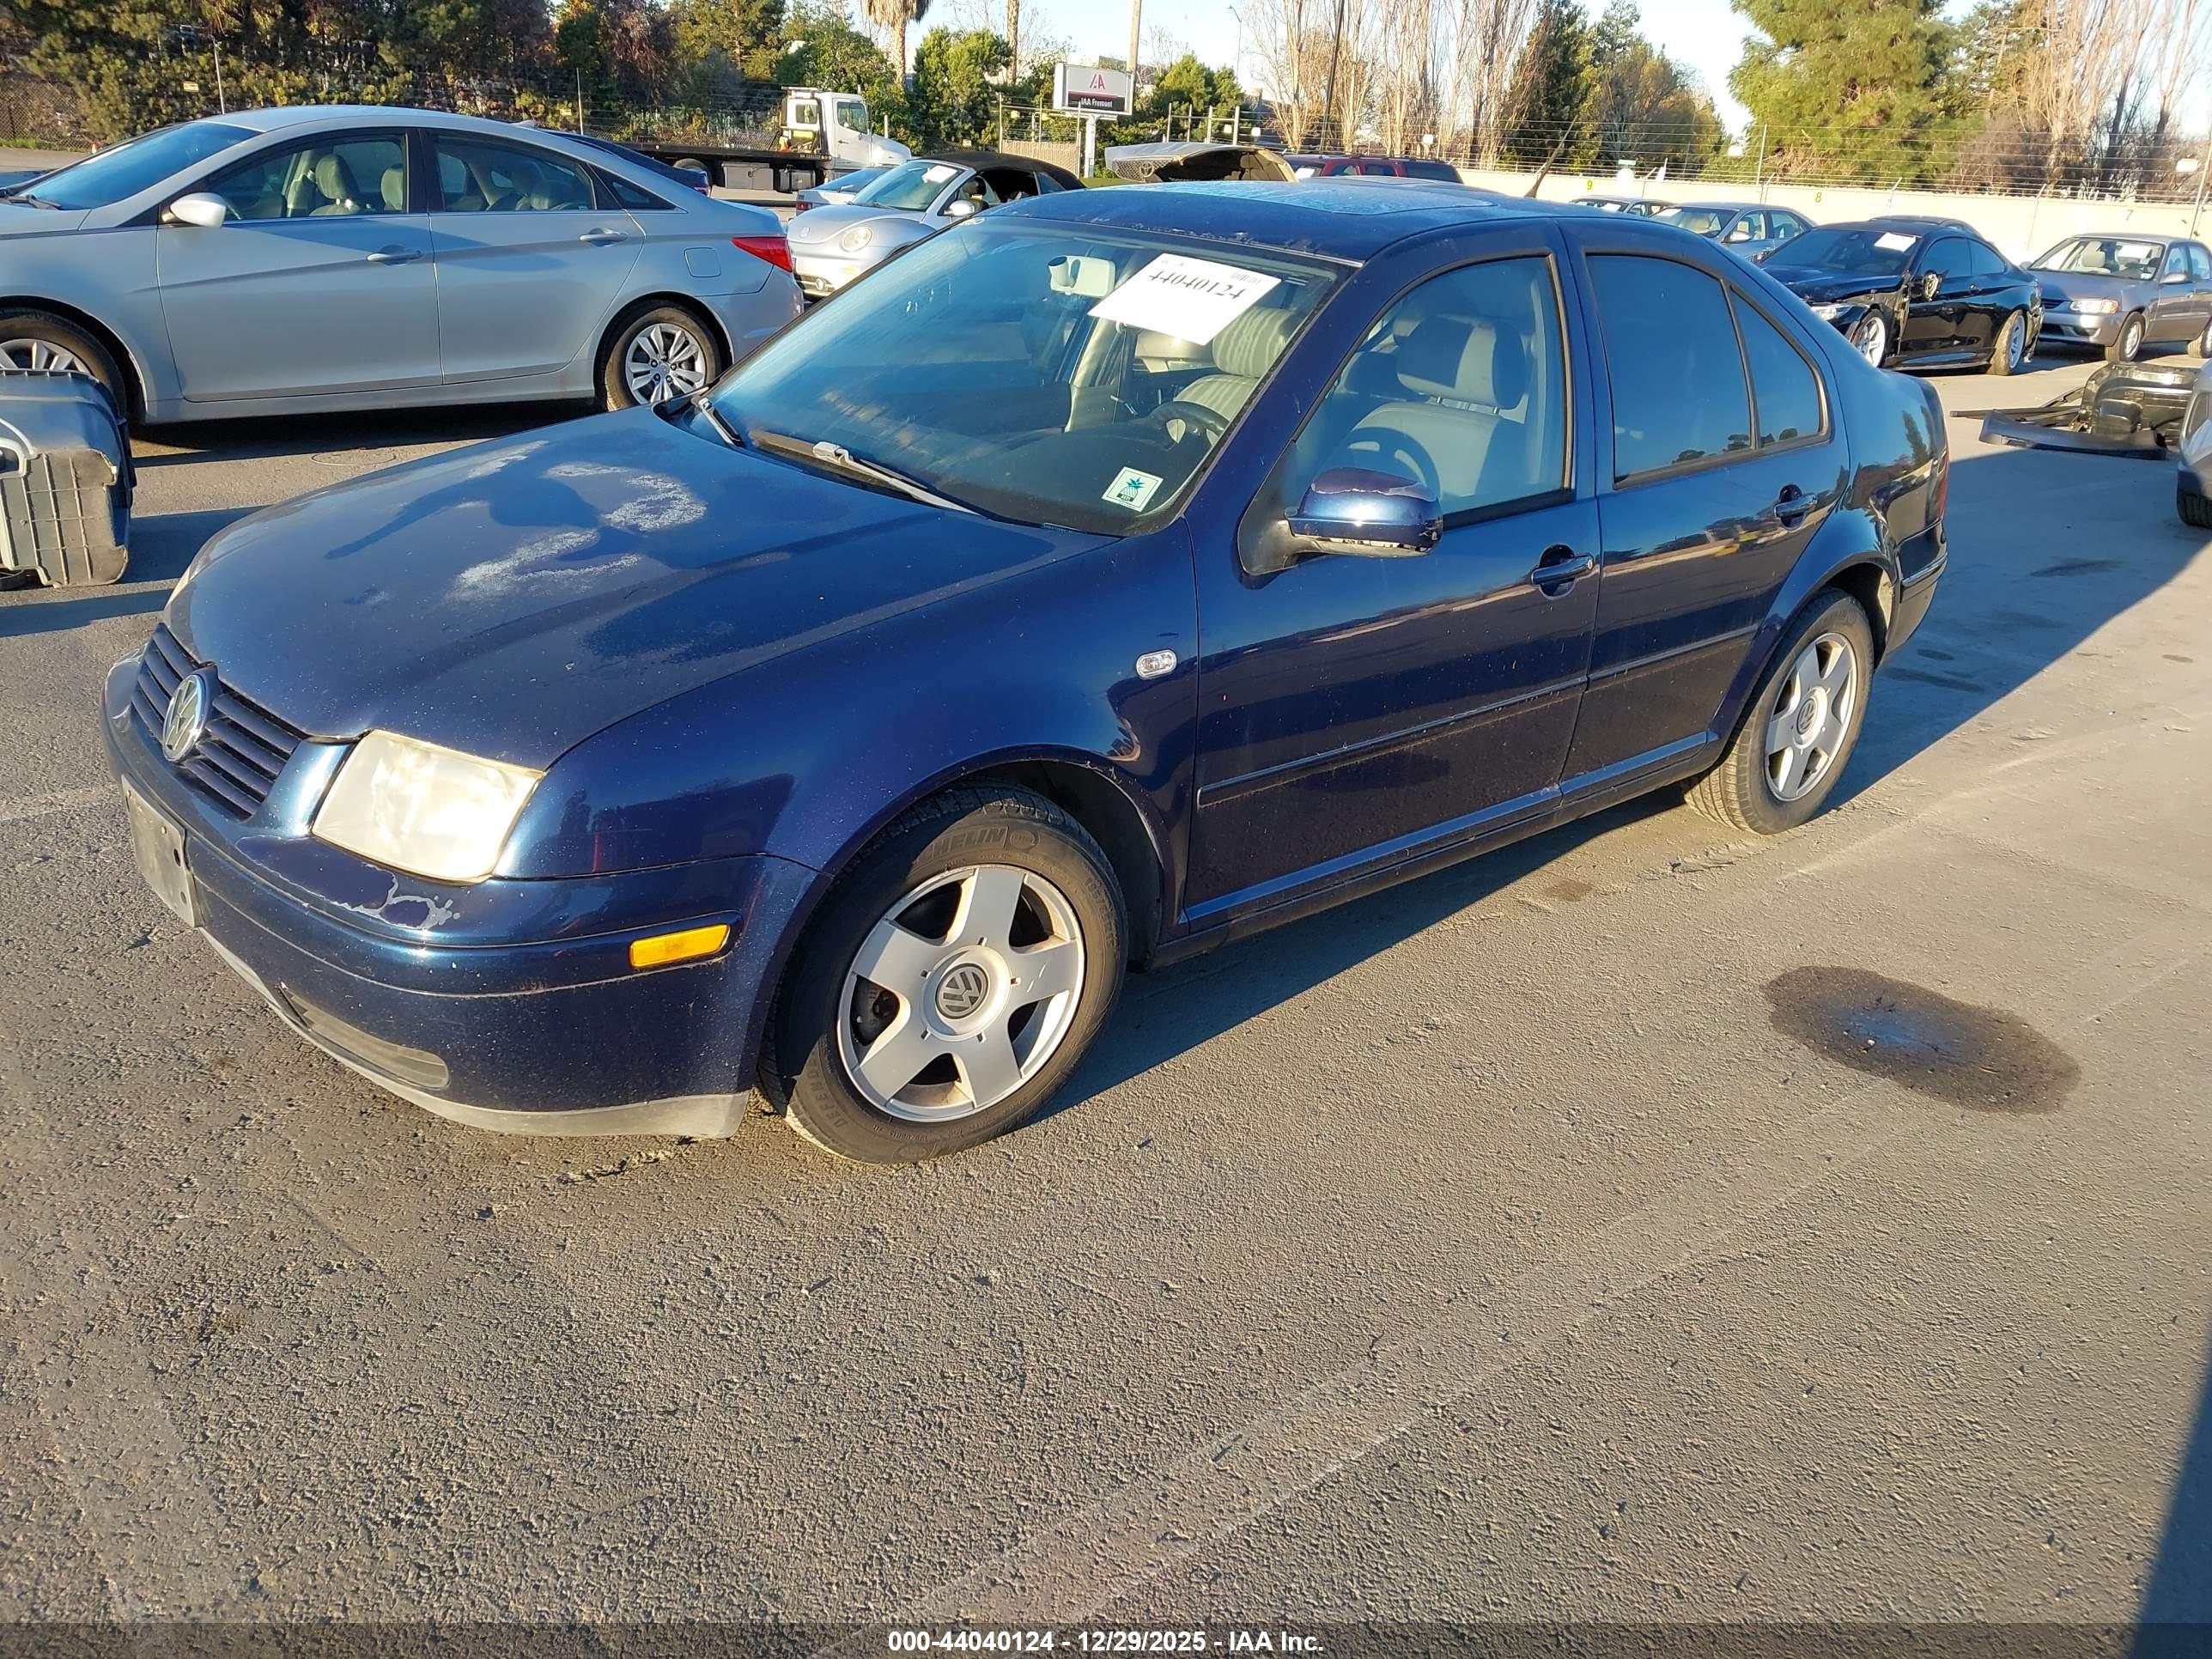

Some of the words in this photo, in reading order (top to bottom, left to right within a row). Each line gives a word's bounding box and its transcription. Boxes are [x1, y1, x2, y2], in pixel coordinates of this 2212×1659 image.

[1091, 99, 1113, 107] Fremont
[1587, 179, 1593, 191] 9
[1814, 191, 1822, 203] 8
[1149, 270, 1246, 299] 44040124
